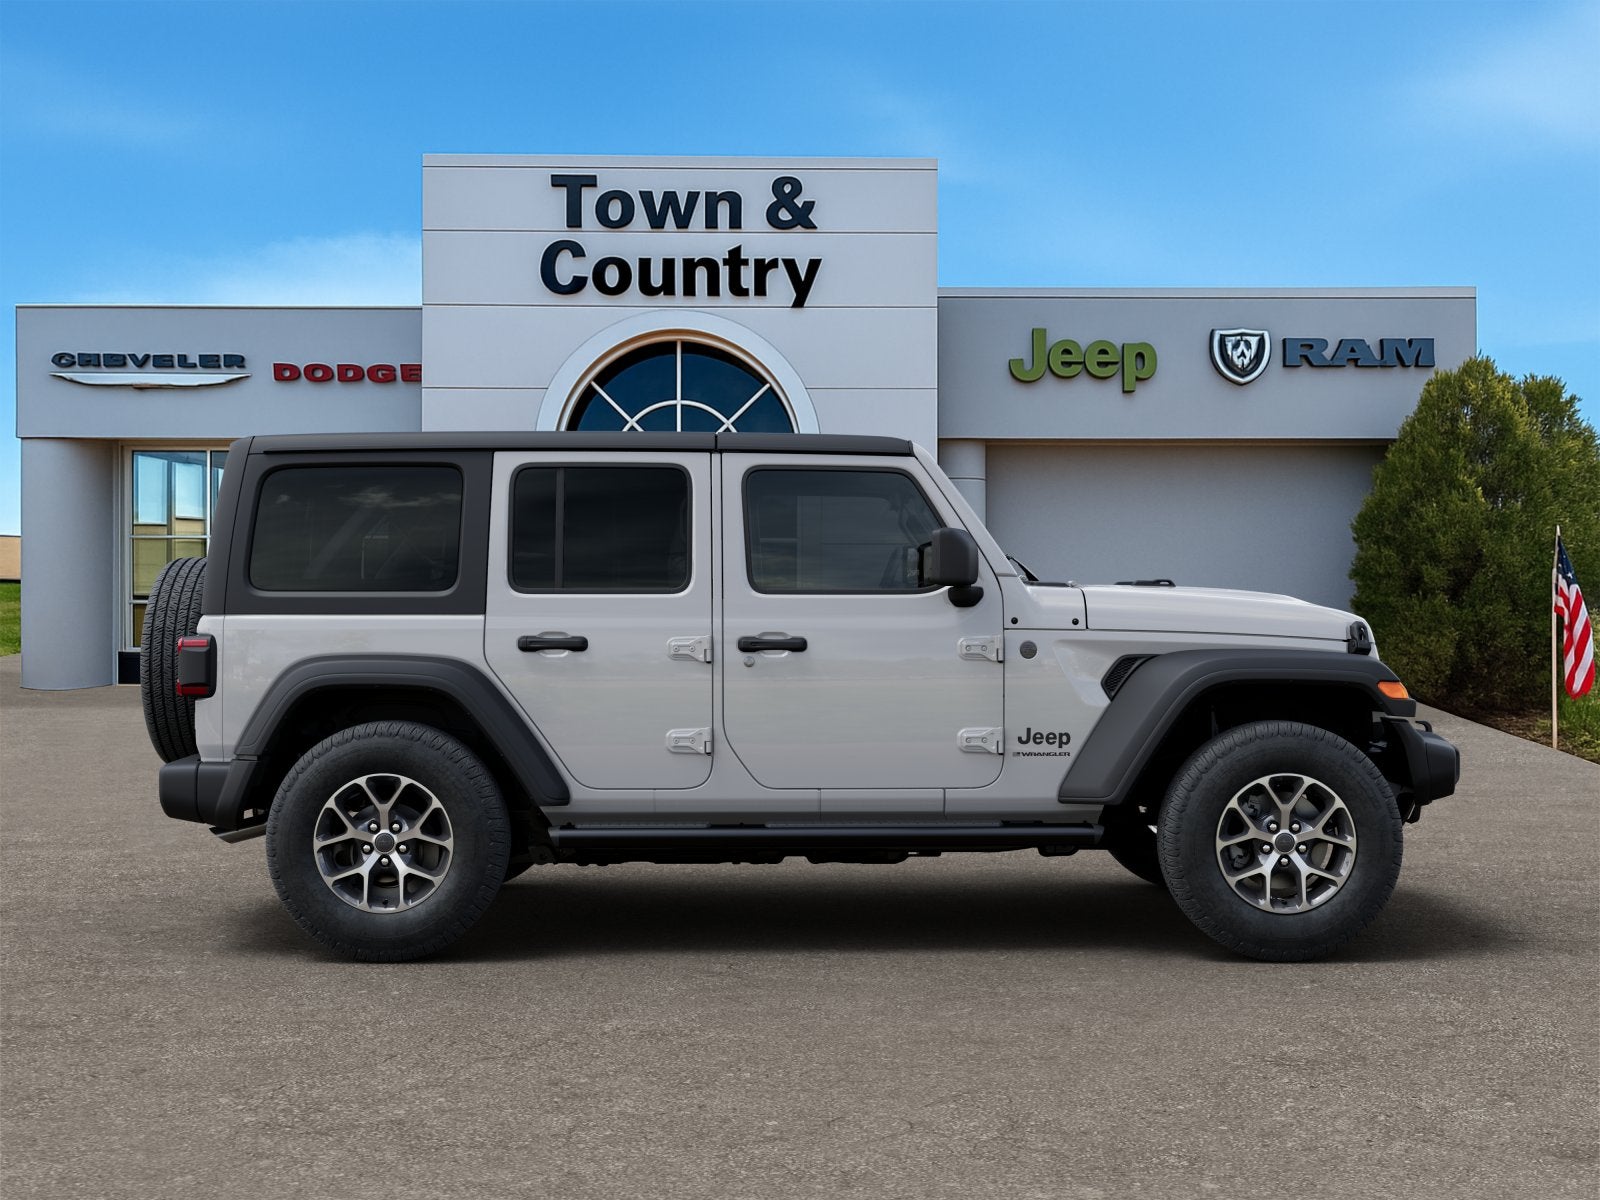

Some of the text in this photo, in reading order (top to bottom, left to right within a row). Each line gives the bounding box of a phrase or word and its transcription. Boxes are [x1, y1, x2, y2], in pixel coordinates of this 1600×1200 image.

[550, 174, 818, 230] Town &
[539, 239, 822, 308] Country
[272, 362, 422, 383] DODGE
[1008, 327, 1158, 394] Jeep
[1282, 337, 1436, 368] RAM
[1017, 727, 1071, 749] Jeep
